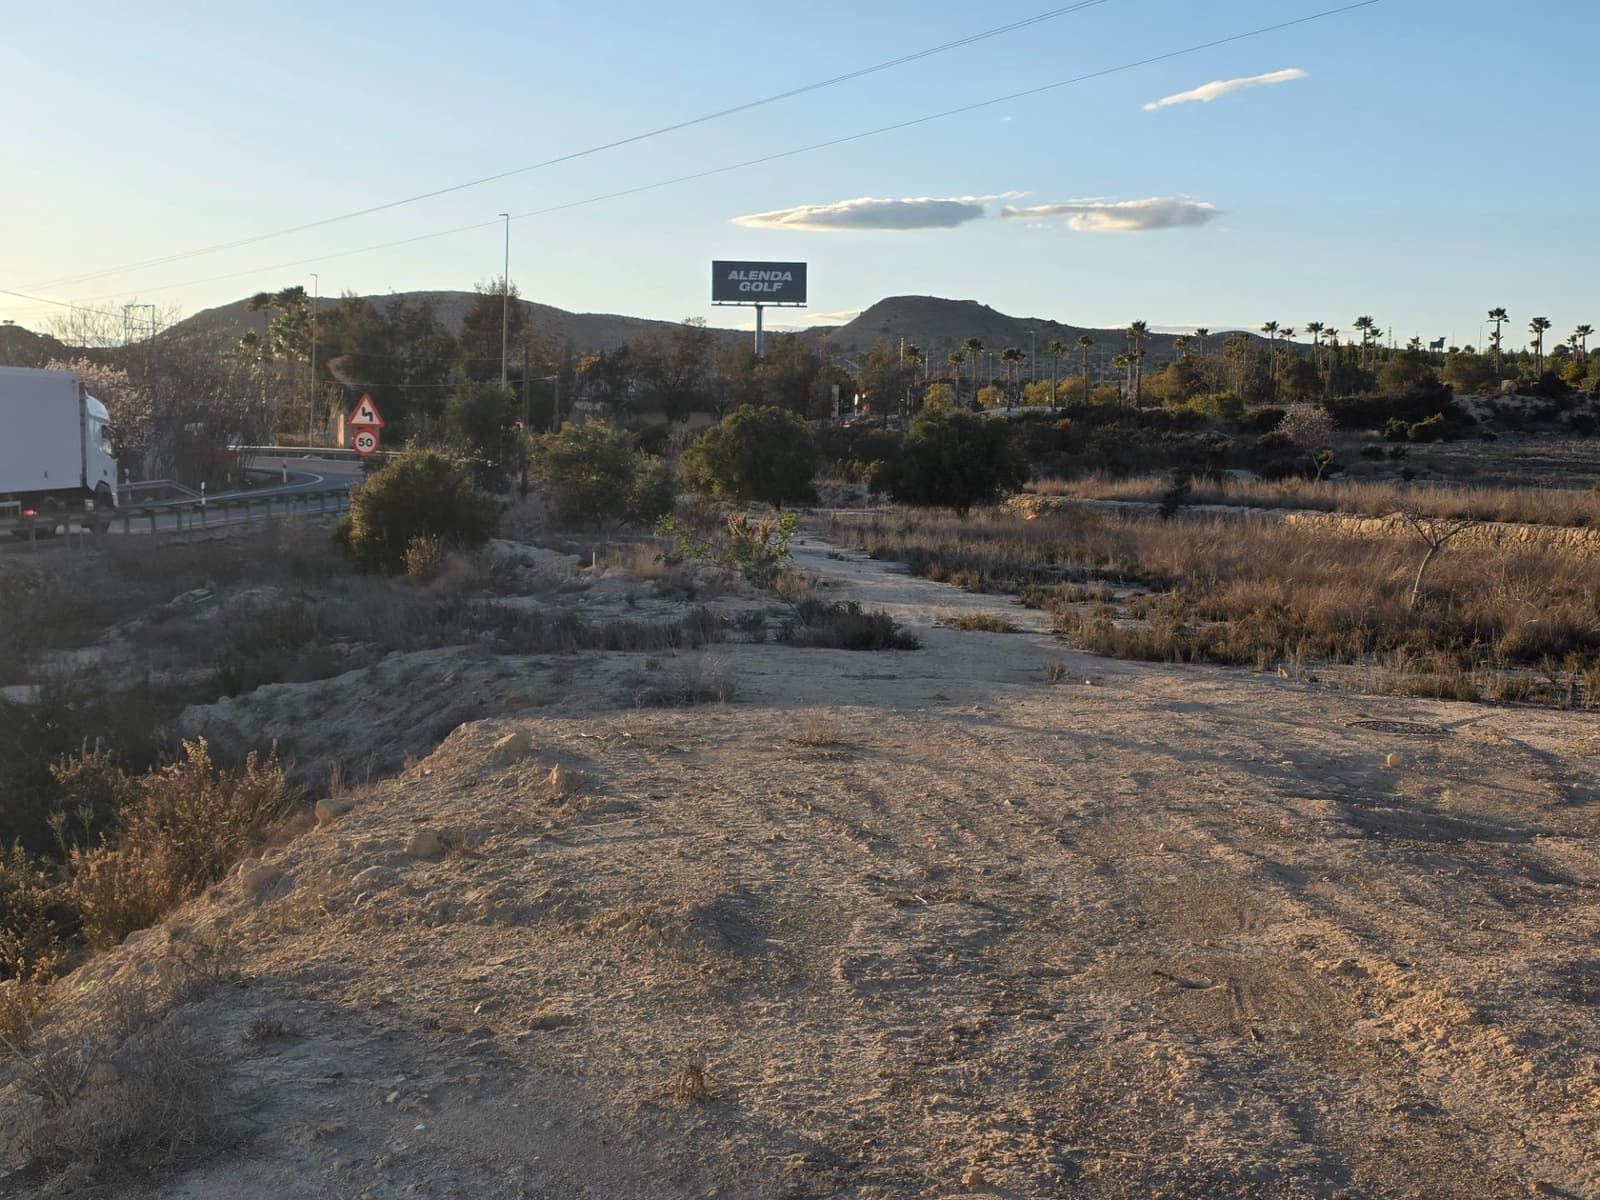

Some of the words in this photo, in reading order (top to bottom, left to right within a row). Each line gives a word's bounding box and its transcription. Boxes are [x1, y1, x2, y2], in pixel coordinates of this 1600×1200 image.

[728, 270, 792, 281] ALENDA
[739, 281, 783, 292] GOLF
[358, 437, 373, 447] 50
